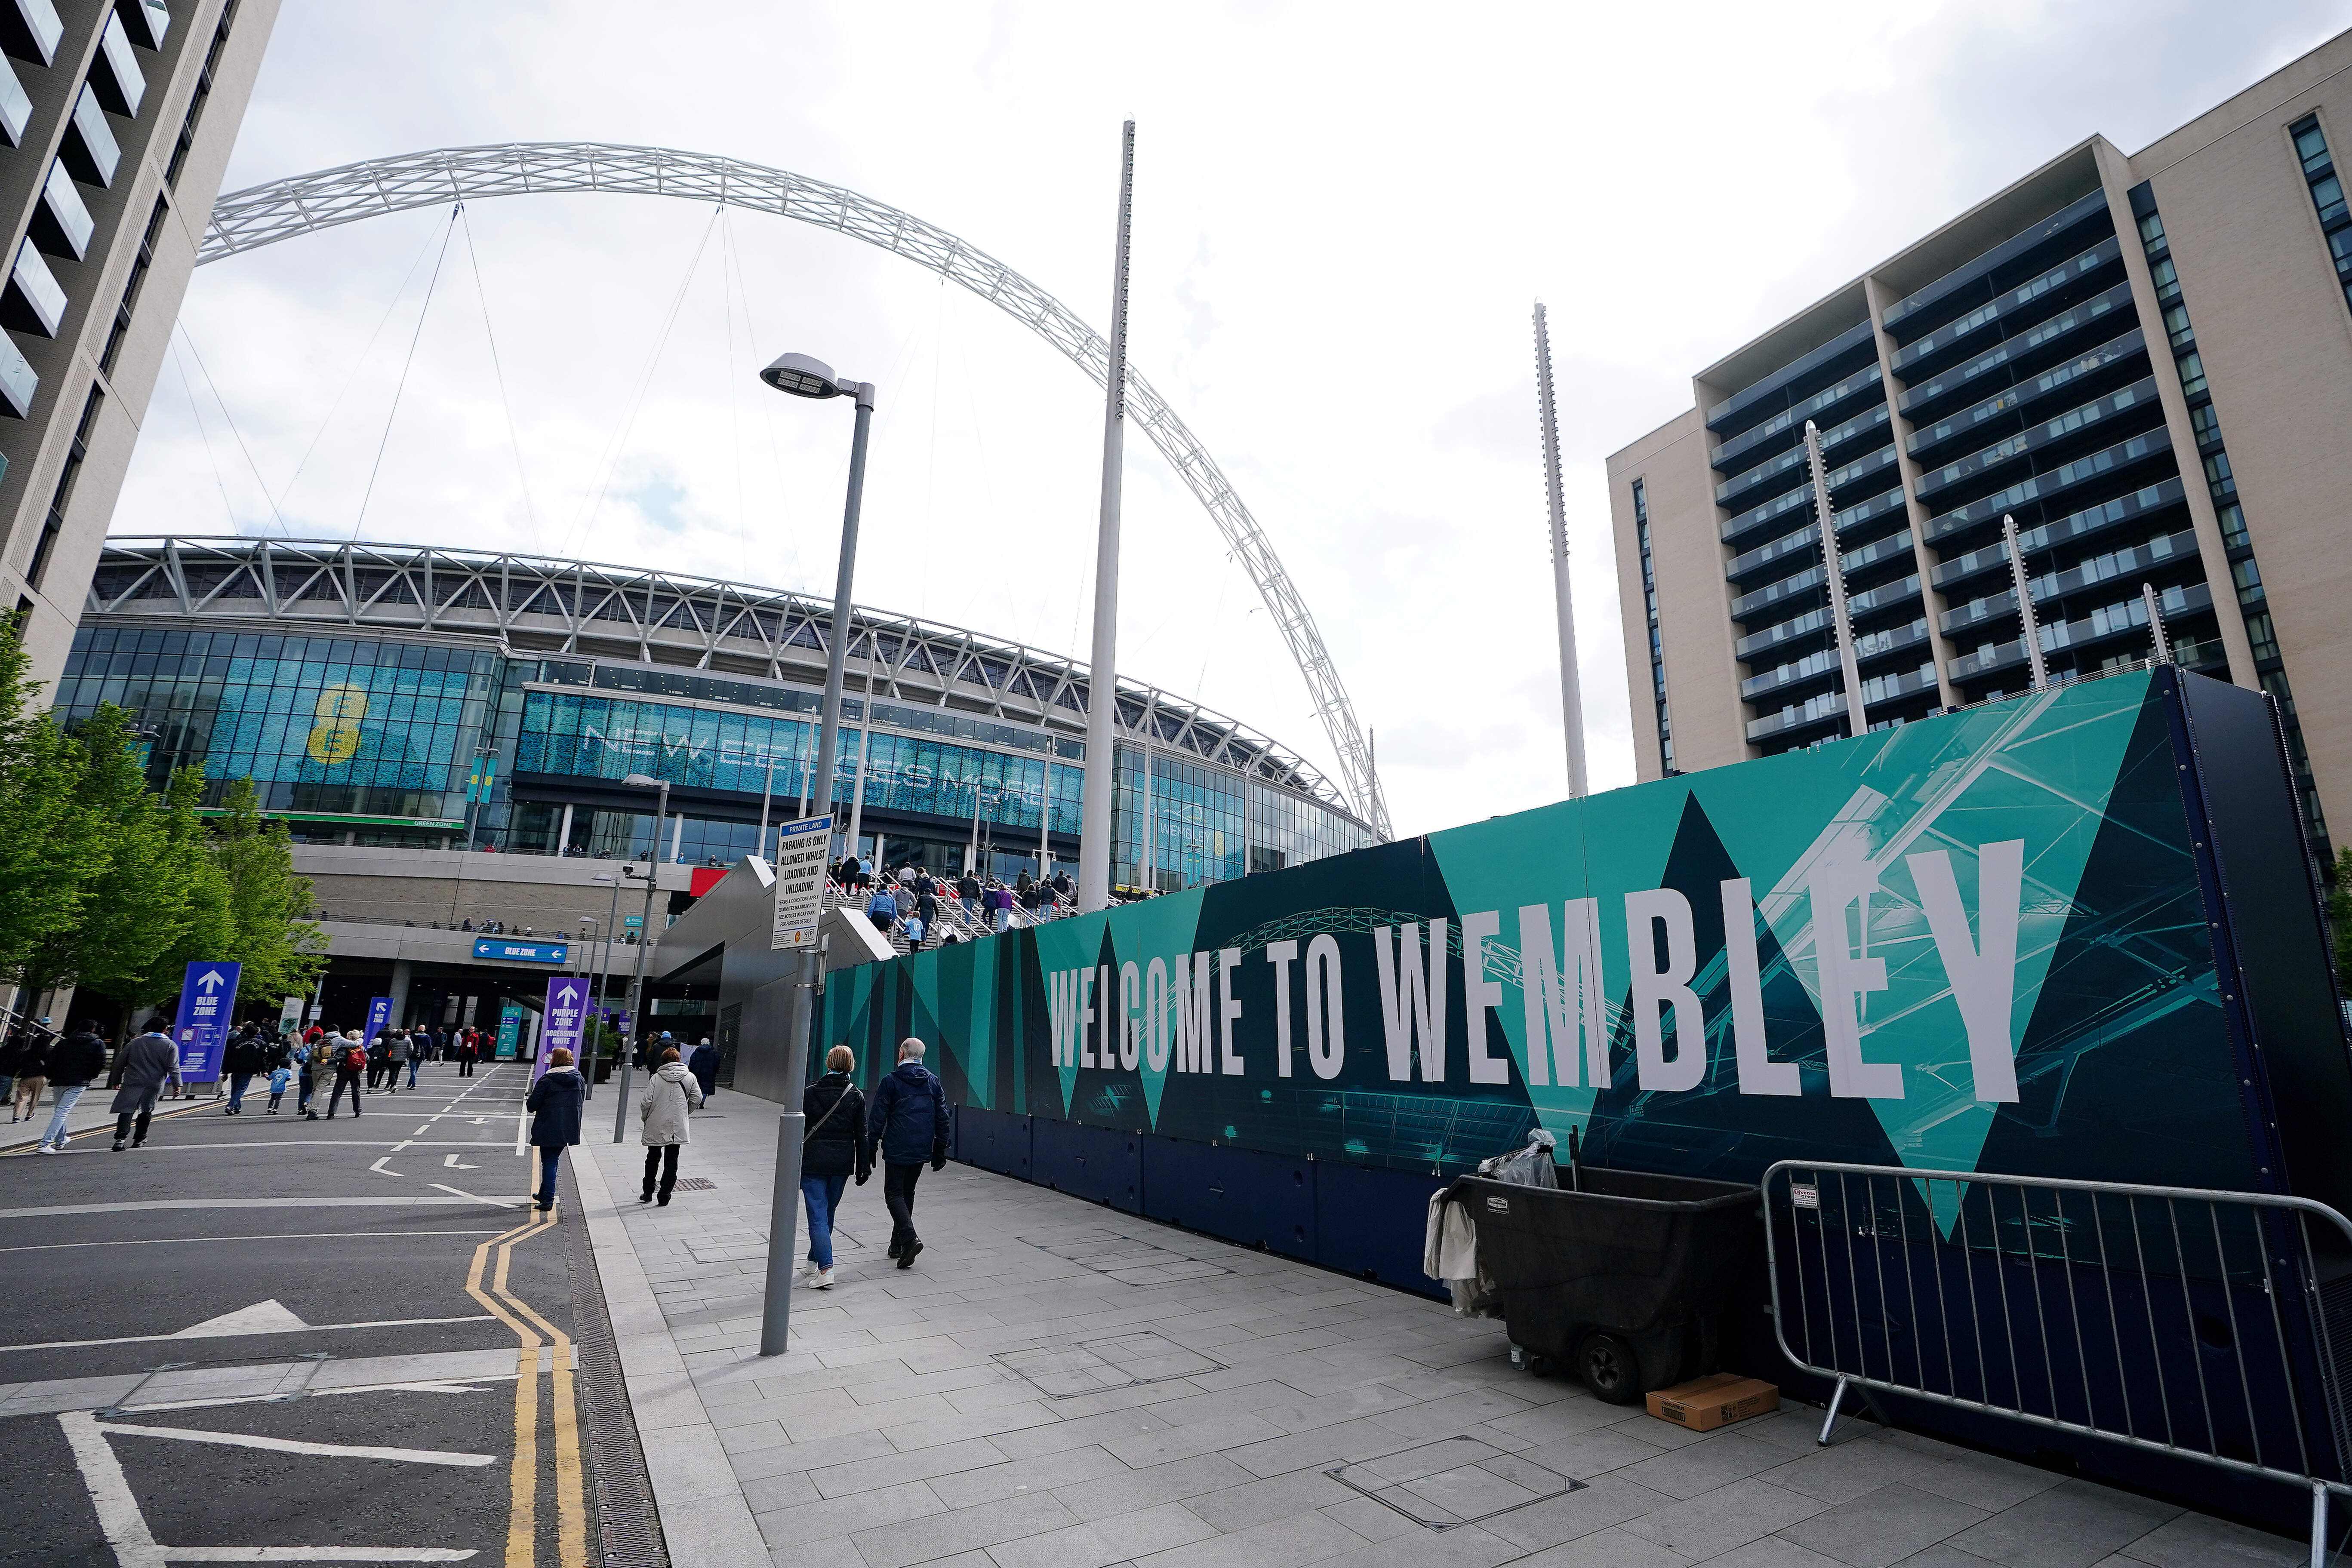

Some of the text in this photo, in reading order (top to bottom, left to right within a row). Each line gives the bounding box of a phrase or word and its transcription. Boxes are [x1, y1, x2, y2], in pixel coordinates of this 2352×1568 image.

[583, 724, 708, 760] NEW
[720, 739, 789, 771] EE
[942, 769, 1053, 808] MORE
[789, 821, 822, 833] PRIVATE LAND
[1160, 822, 1211, 843] WEMBLEY
[782, 834, 828, 852] PARKING IS ONLY
[781, 849, 826, 866] ALLOWED WHILST
[784, 865, 818, 880] LOADING AND
[785, 880, 814, 895] UNLOADING
[505, 947, 536, 957] BLUE ZONE
[1050, 839, 2024, 1103] WELCOME TO WEMBLEY
[196, 996, 219, 1005] BLUE
[193, 1007, 217, 1015] ZONE
[552, 1008, 579, 1017] PURPLE
[555, 1018, 573, 1026] ZONE
[275, 1074, 283, 1083] 9
